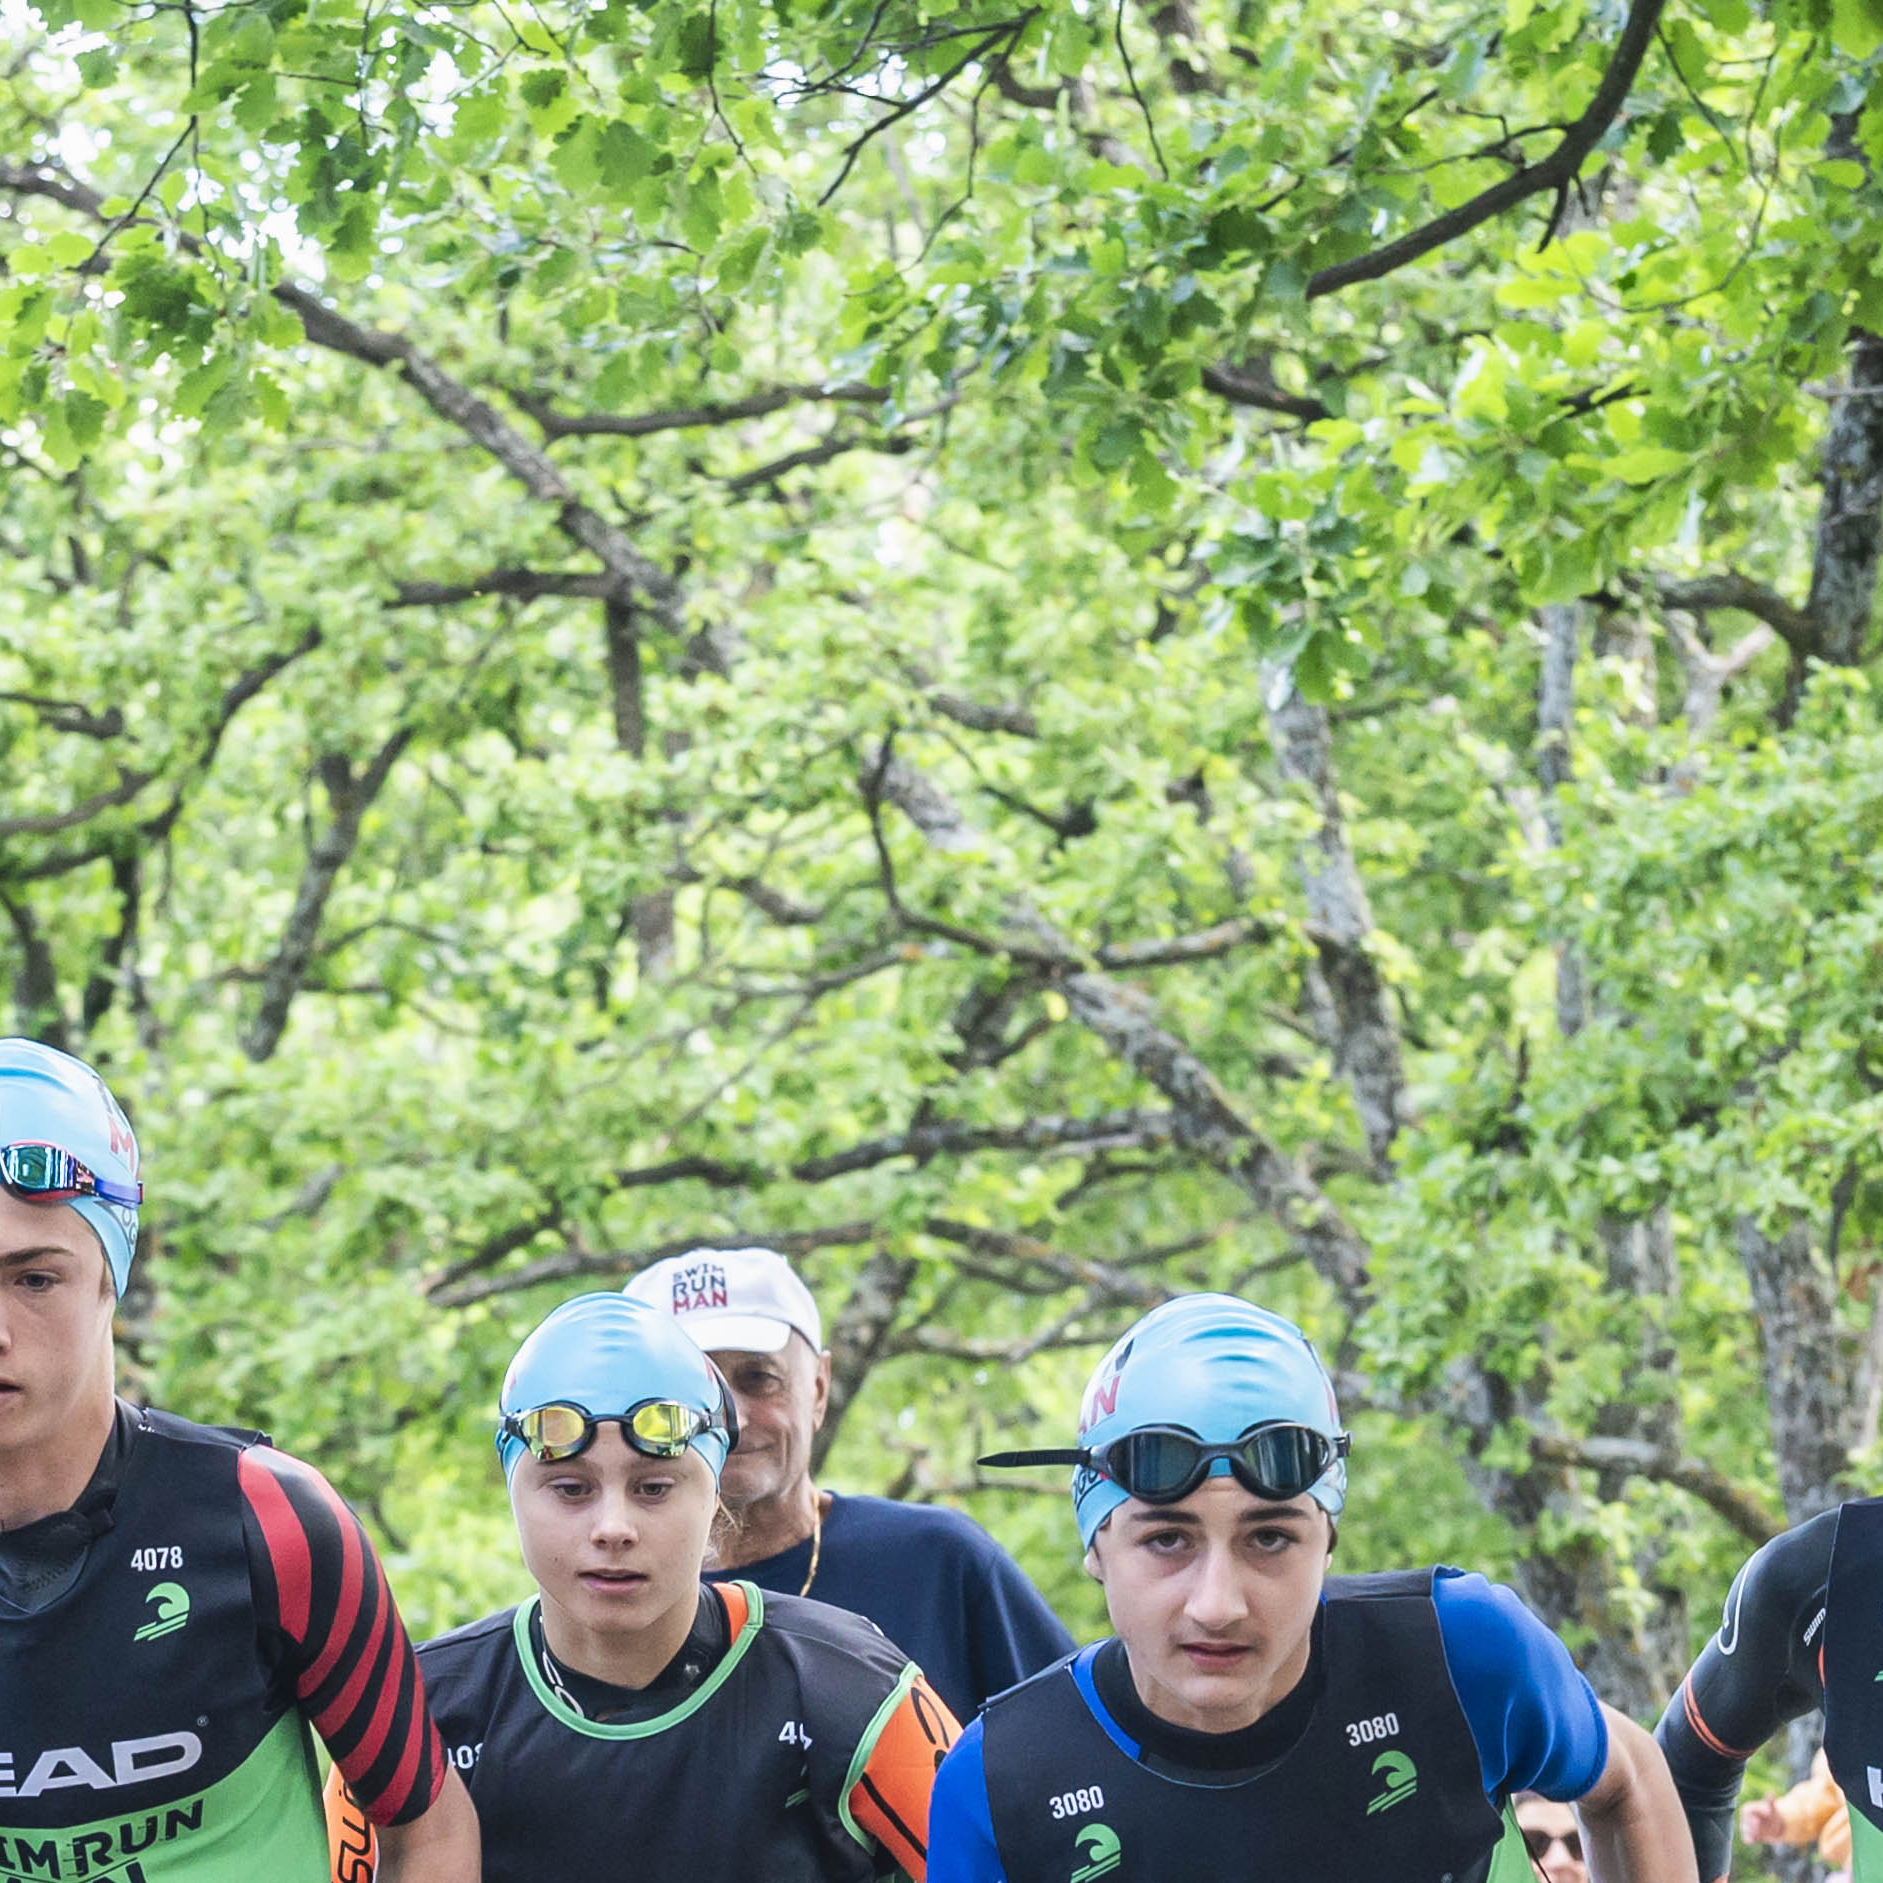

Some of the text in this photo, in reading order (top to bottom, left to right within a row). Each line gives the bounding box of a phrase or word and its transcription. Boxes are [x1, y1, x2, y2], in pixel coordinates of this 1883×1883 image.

[673, 1275, 726, 1297] RUN
[673, 1290, 728, 1315] MAN
[131, 1545, 184, 1572] 4078
[1345, 1712, 1401, 1747] 3080
[1049, 1785, 1105, 1820] 3080
